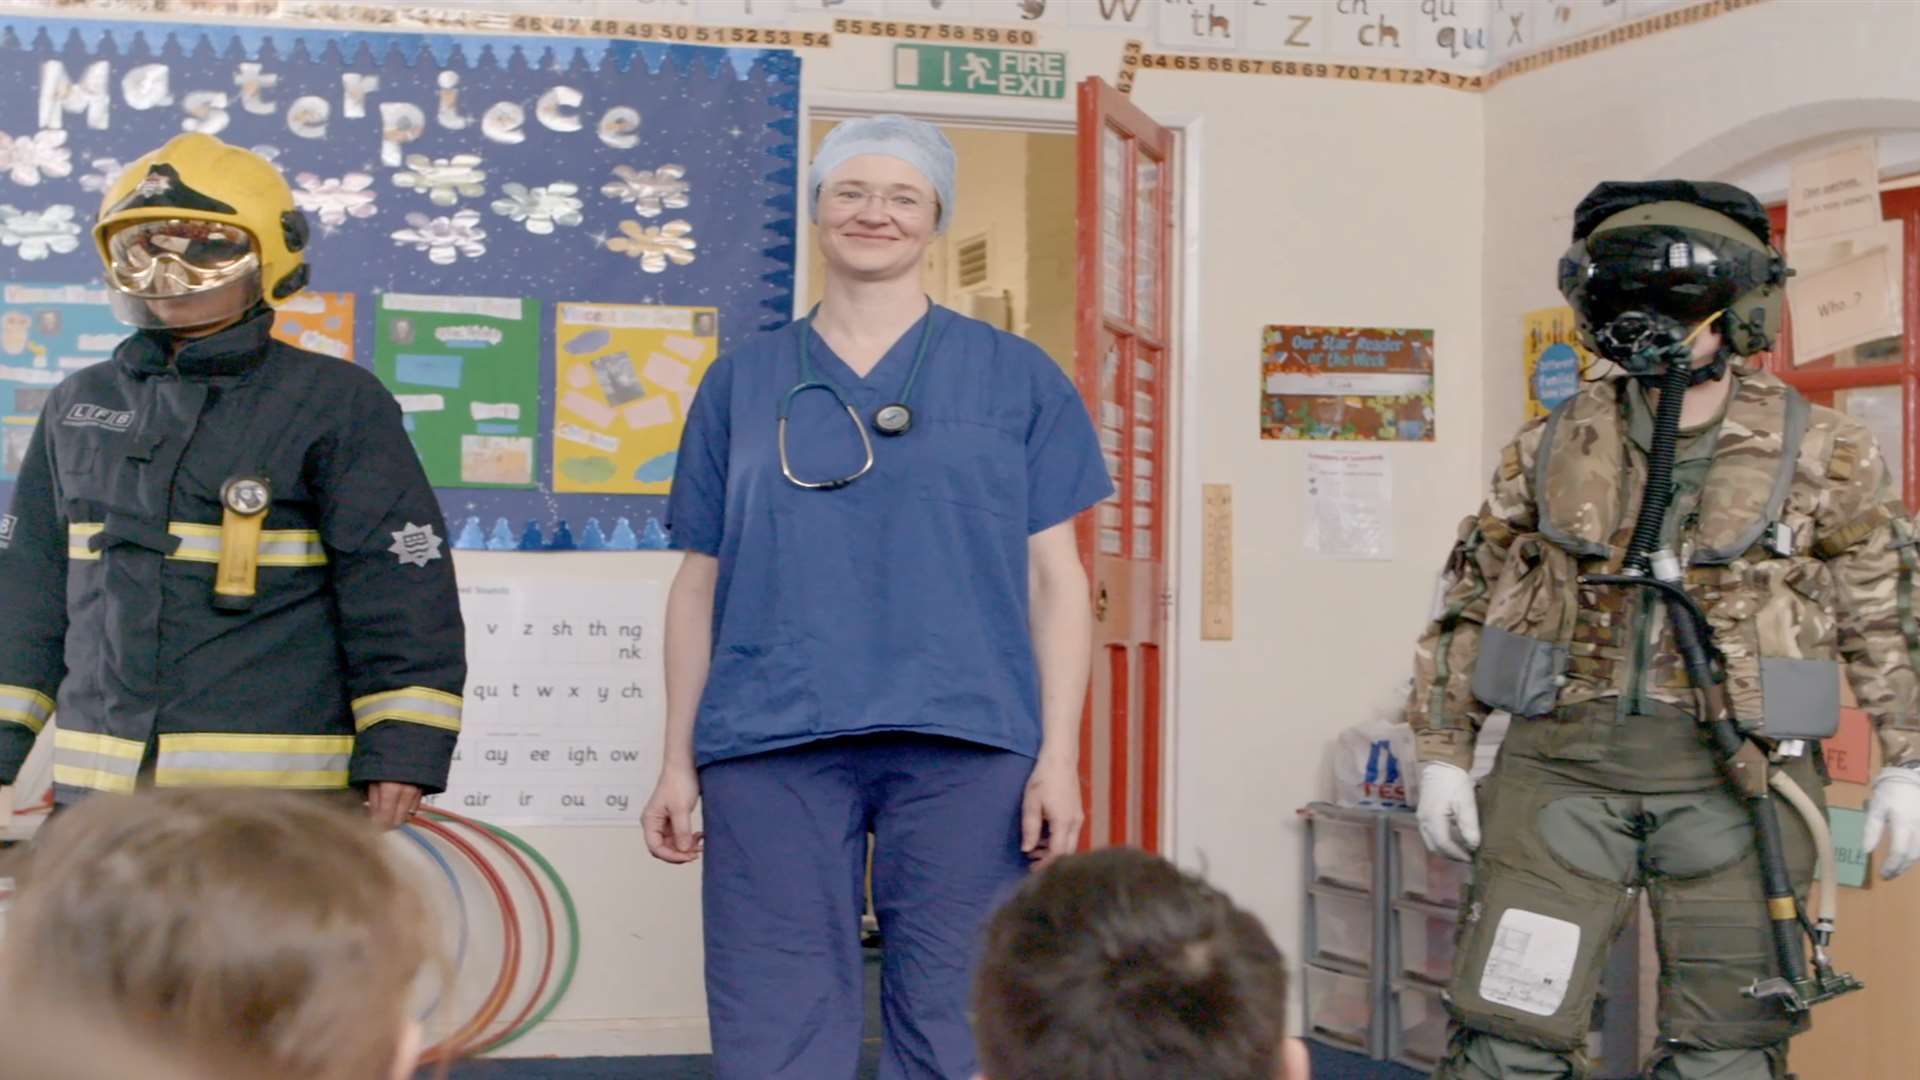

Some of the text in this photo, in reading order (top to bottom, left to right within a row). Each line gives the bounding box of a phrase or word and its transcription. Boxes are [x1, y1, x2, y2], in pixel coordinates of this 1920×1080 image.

[513, 16, 542, 31] 46
[590, 19, 619, 35] 48
[624, 23, 652, 38] 49
[660, 25, 688, 40] 50
[696, 27, 725, 42] 51
[731, 28, 758, 42] 52
[764, 30, 791, 45] 53
[802, 33, 830, 46] 54
[834, 20, 1034, 45] 55 56 57 58 59 60
[1437, 26, 1488, 59] qu
[1000, 51, 1063, 75] FIRE
[1118, 42, 1141, 94] 62 63
[1142, 54, 1168, 69] 64
[1174, 56, 1200, 70] 65
[1207, 57, 1233, 72] 66
[1238, 59, 1264, 74] 67
[1271, 61, 1297, 75] 68
[1302, 64, 1327, 77] 69
[1334, 65, 1360, 80] 70
[1367, 67, 1392, 81] 71
[1399, 69, 1424, 84] 72
[1426, 68, 1450, 84] 73
[1457, 75, 1483, 89] 74
[1000, 74, 1063, 97] EXIT
[38, 59, 642, 167] Masterpiece
[486, 619, 643, 641] v z sh th ng
[618, 643, 643, 660] nk
[473, 682, 643, 702] qu t w x y ch
[485, 749, 508, 766] ay
[530, 749, 550, 762] ee
[567, 746, 598, 765] igh
[610, 750, 639, 762] ow
[464, 791, 629, 810] air ir ou oy
